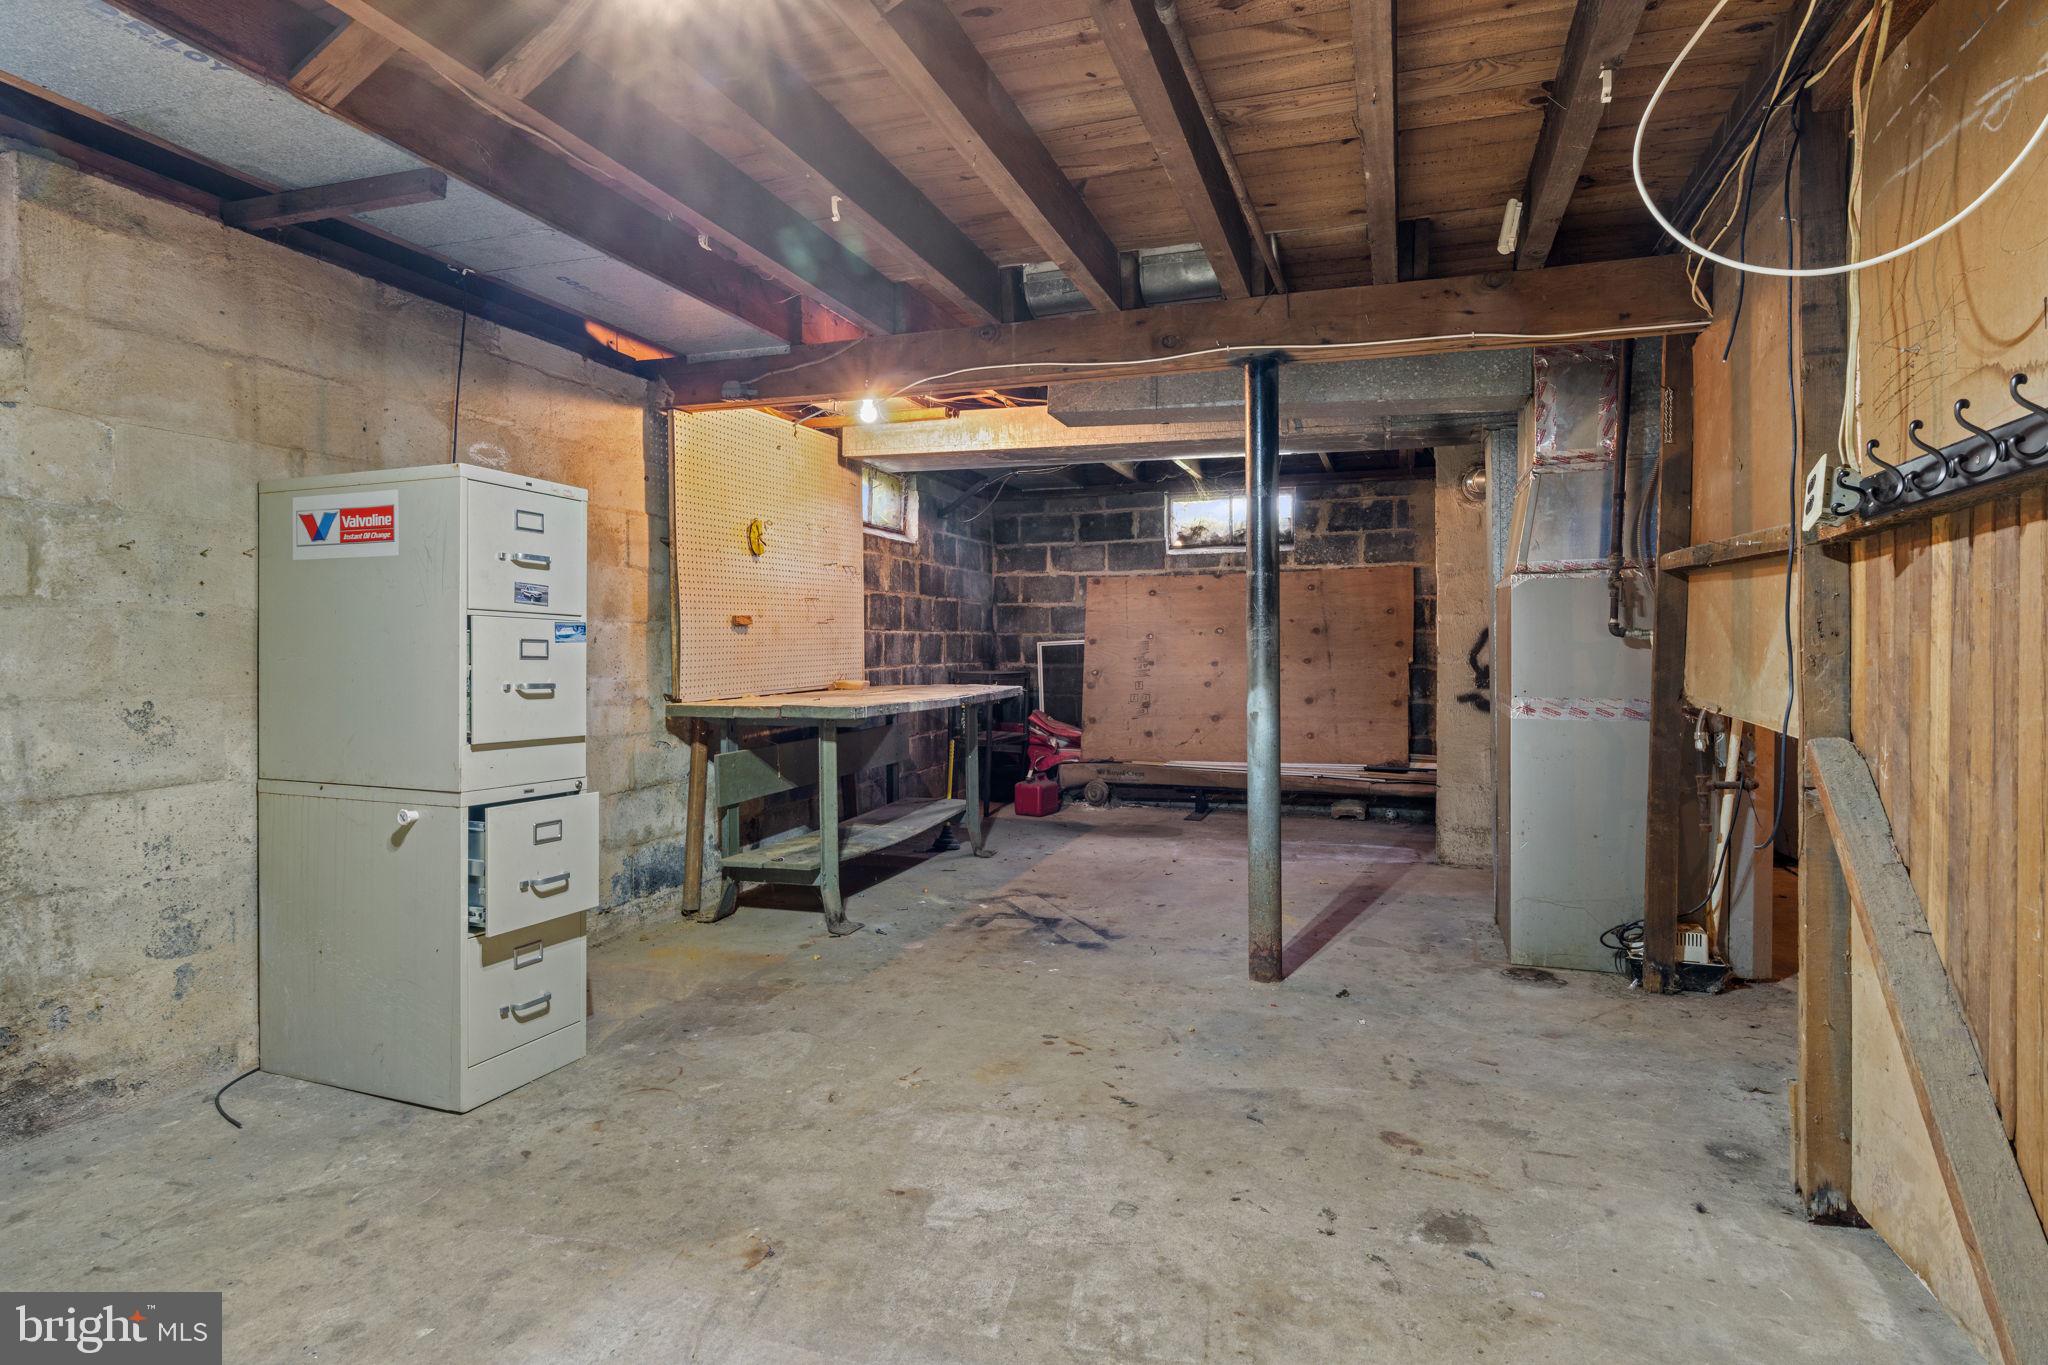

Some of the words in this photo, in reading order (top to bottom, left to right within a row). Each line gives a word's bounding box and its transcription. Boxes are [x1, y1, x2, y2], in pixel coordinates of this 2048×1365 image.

[342, 513, 392, 528] Valvoline
[343, 532, 363, 540] Instant
[371, 531, 391, 540] Change
